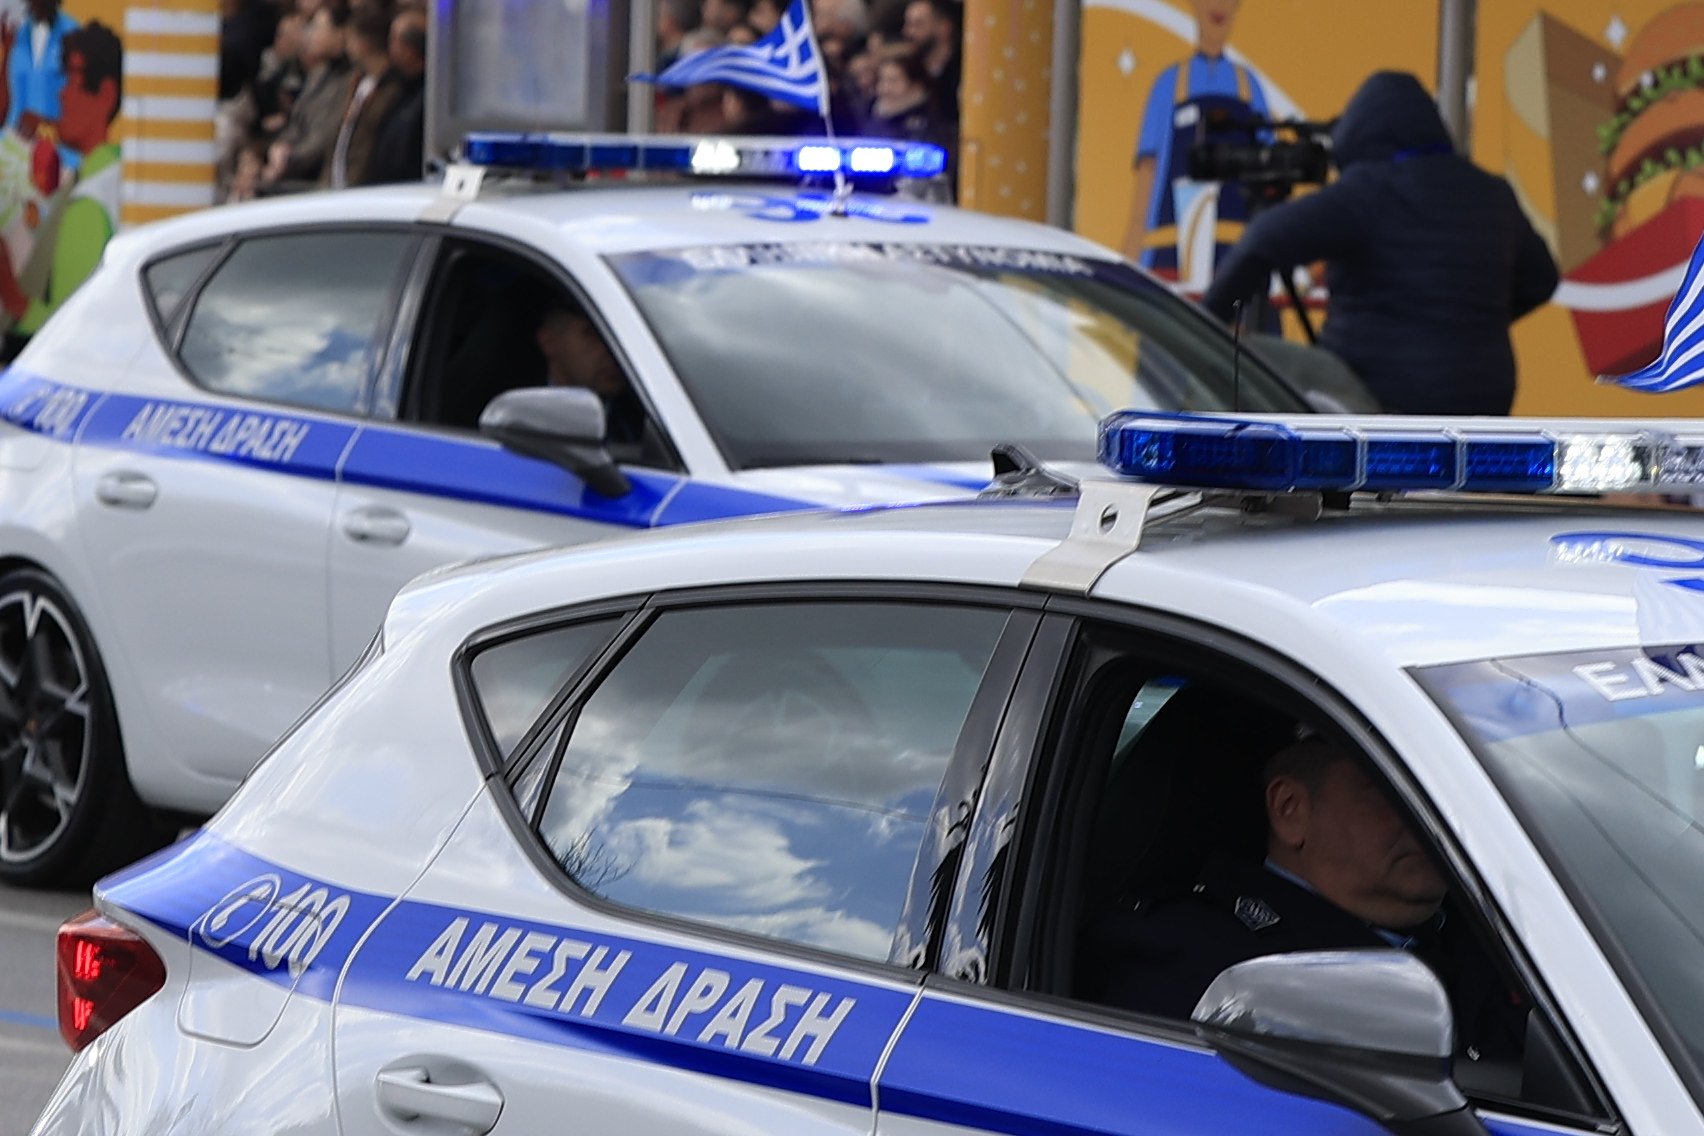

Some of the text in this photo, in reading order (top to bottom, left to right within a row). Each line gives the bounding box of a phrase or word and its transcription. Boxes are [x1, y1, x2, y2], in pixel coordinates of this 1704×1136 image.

[120, 400, 311, 463] ΑΜΕΣΗ ΔΡΑΣΗ
[404, 916, 857, 1067] ΑΜΕΣΗ ΔΡΑΣΗ
